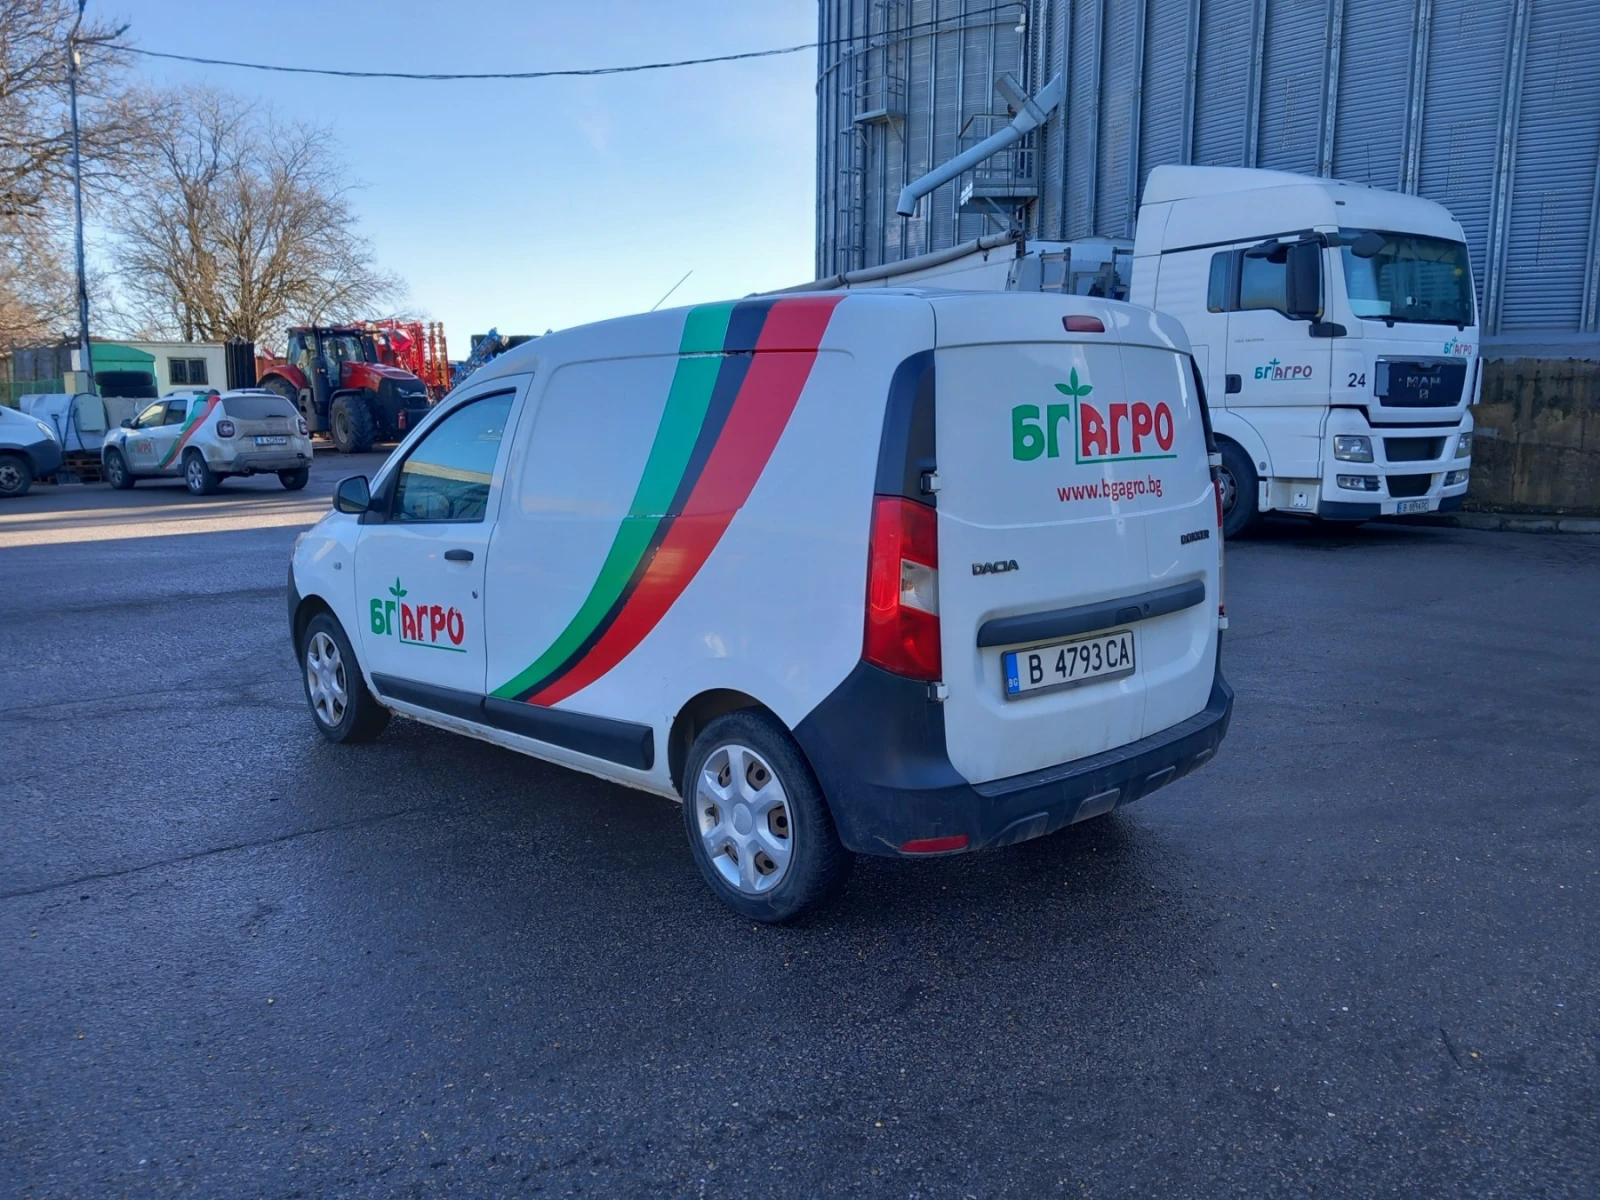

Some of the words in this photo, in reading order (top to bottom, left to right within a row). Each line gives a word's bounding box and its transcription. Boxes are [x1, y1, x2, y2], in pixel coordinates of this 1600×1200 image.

[1274, 365, 1312, 378] АГРО
[1347, 372, 1366, 388] 24
[1406, 376, 1441, 388] MAN
[1079, 401, 1174, 457] АГРО
[1057, 474, 1162, 502] www.bgagro.bg
[972, 559, 1019, 576] DACIA
[401, 602, 465, 645] АГРО
[1028, 654, 1043, 684] B
[1008, 678, 1018, 688] BG
